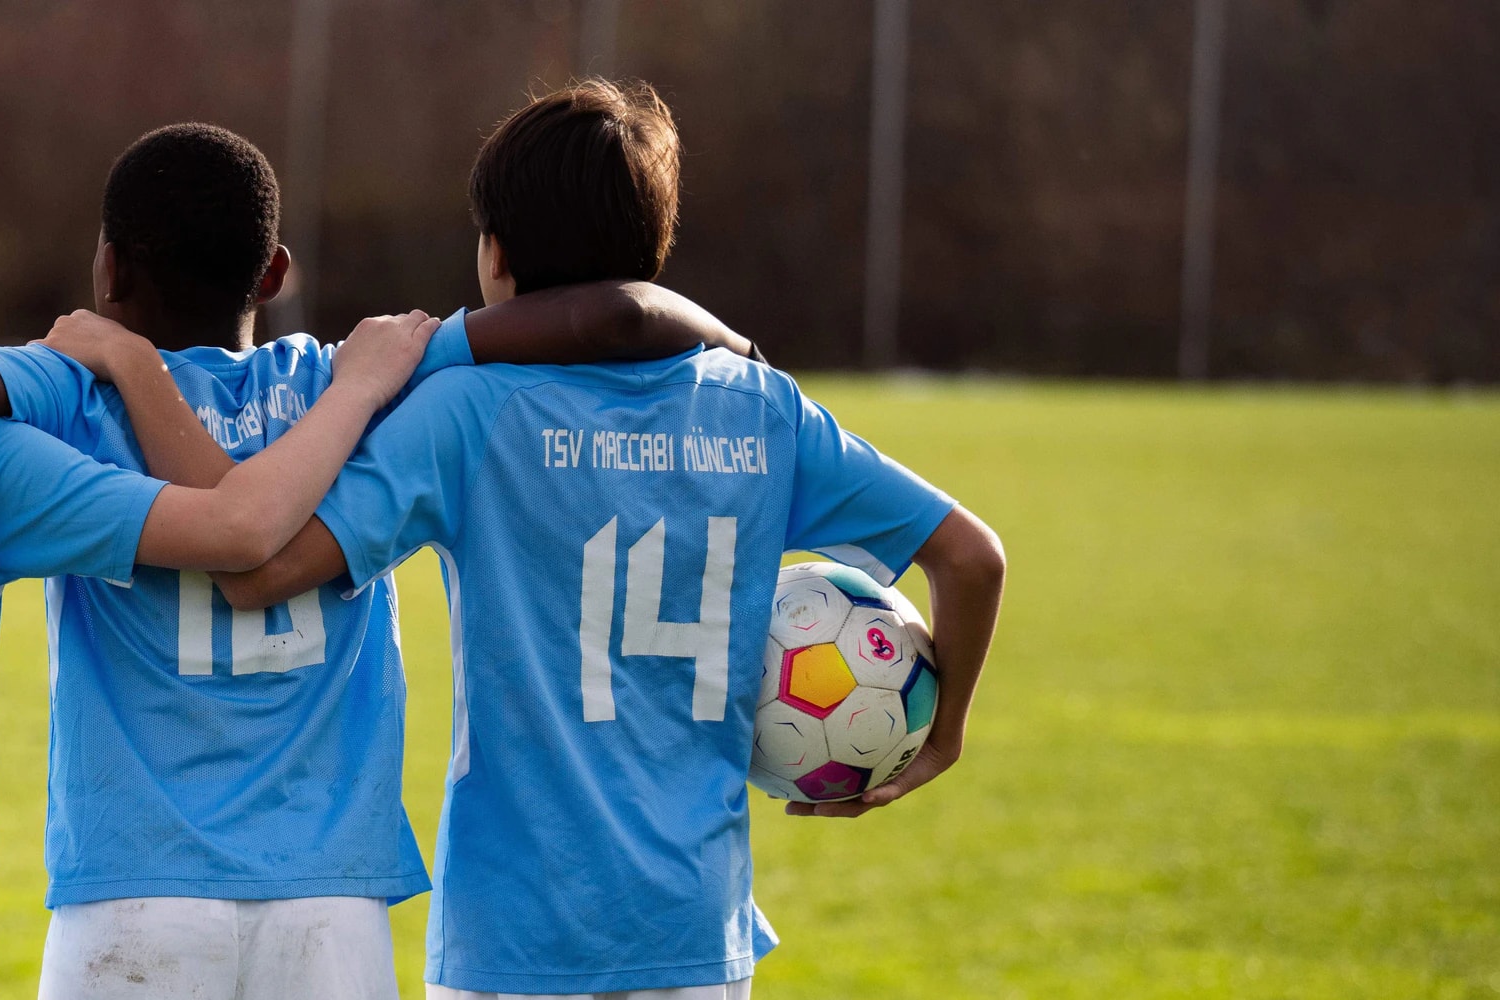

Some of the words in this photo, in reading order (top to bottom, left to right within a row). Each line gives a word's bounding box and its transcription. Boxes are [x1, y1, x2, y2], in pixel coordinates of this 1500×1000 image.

[541, 428, 584, 468] TSV
[593, 430, 674, 472] MACCABI
[683, 426, 768, 475] MÜNCHEN
[579, 515, 737, 722] 14
